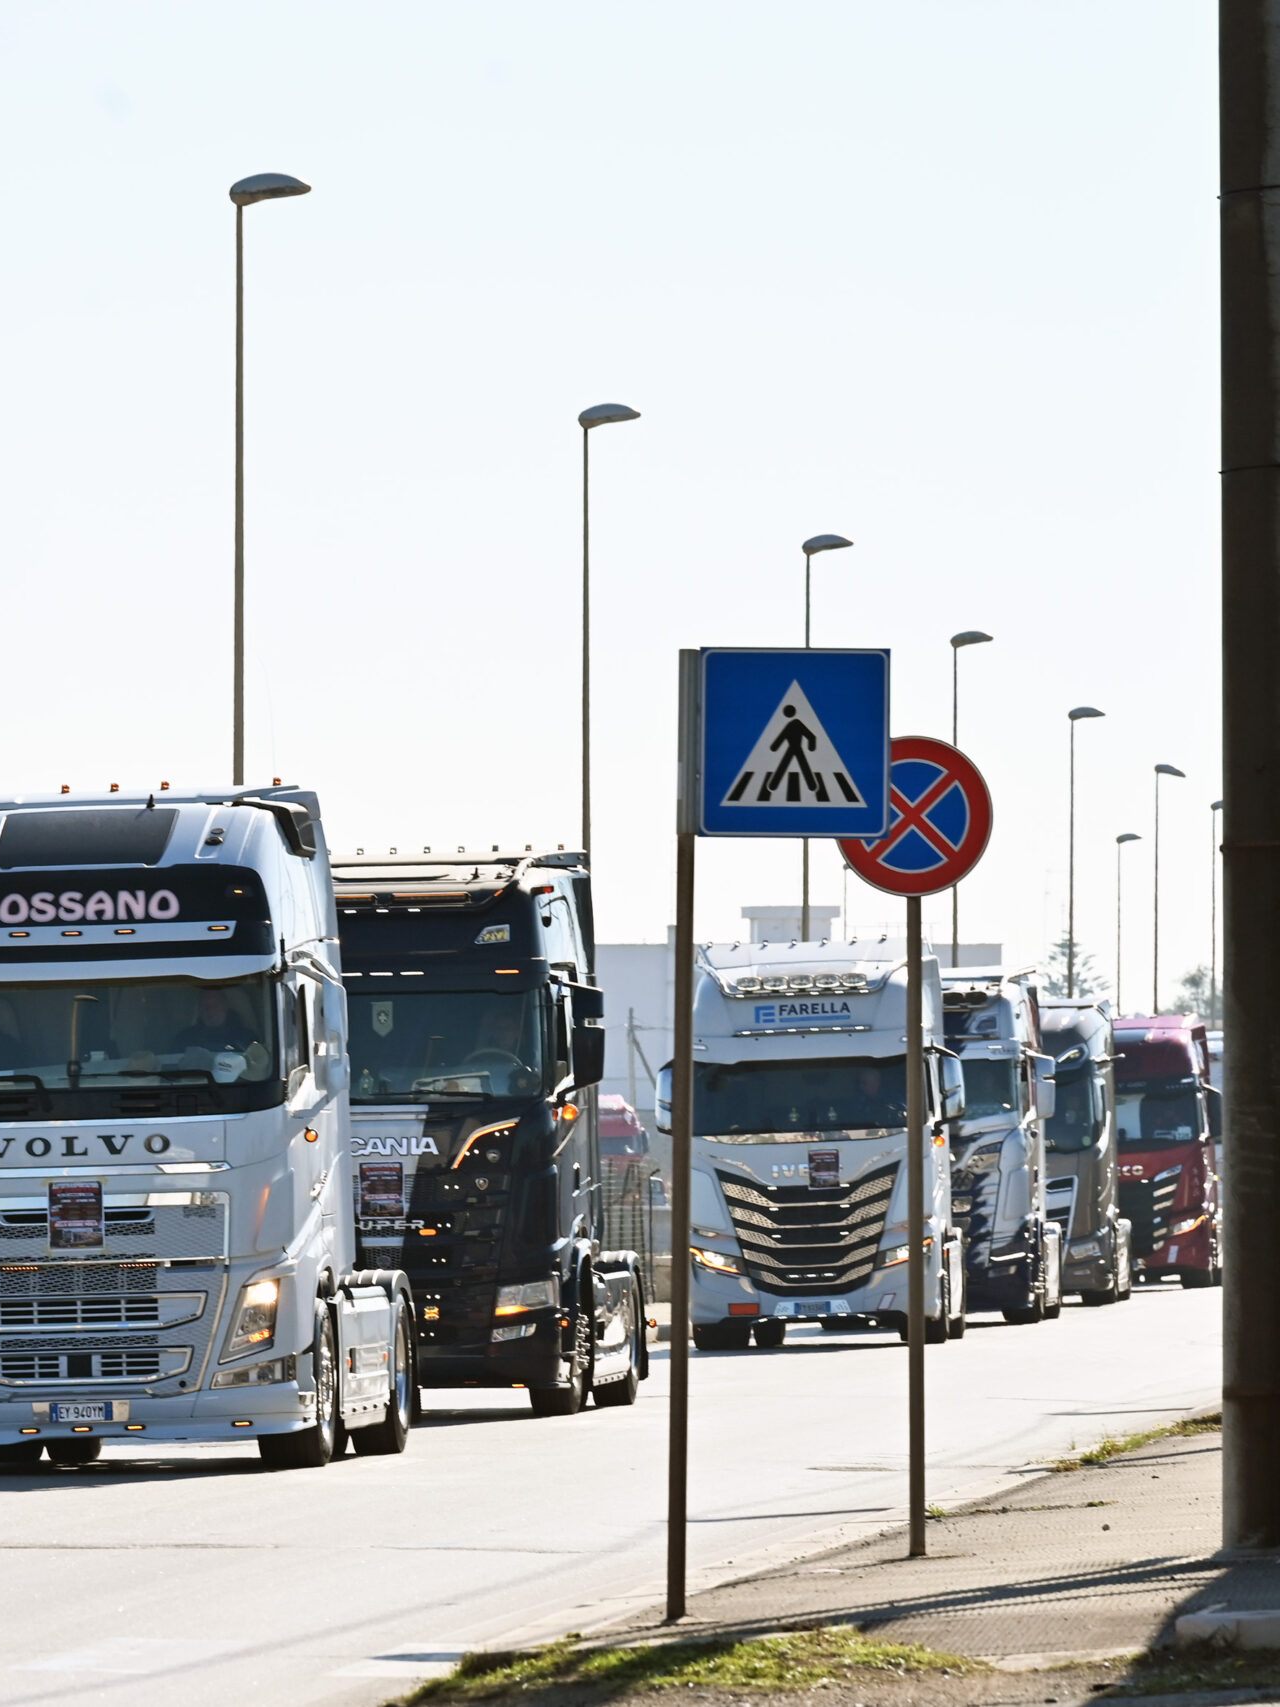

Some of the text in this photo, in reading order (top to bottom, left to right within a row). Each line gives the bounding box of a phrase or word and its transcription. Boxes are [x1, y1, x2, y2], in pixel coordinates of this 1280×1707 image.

[779, 1002, 851, 1016] FARELLA
[350, 1136, 439, 1157] CANIA
[354, 1219, 426, 1231] UPER
